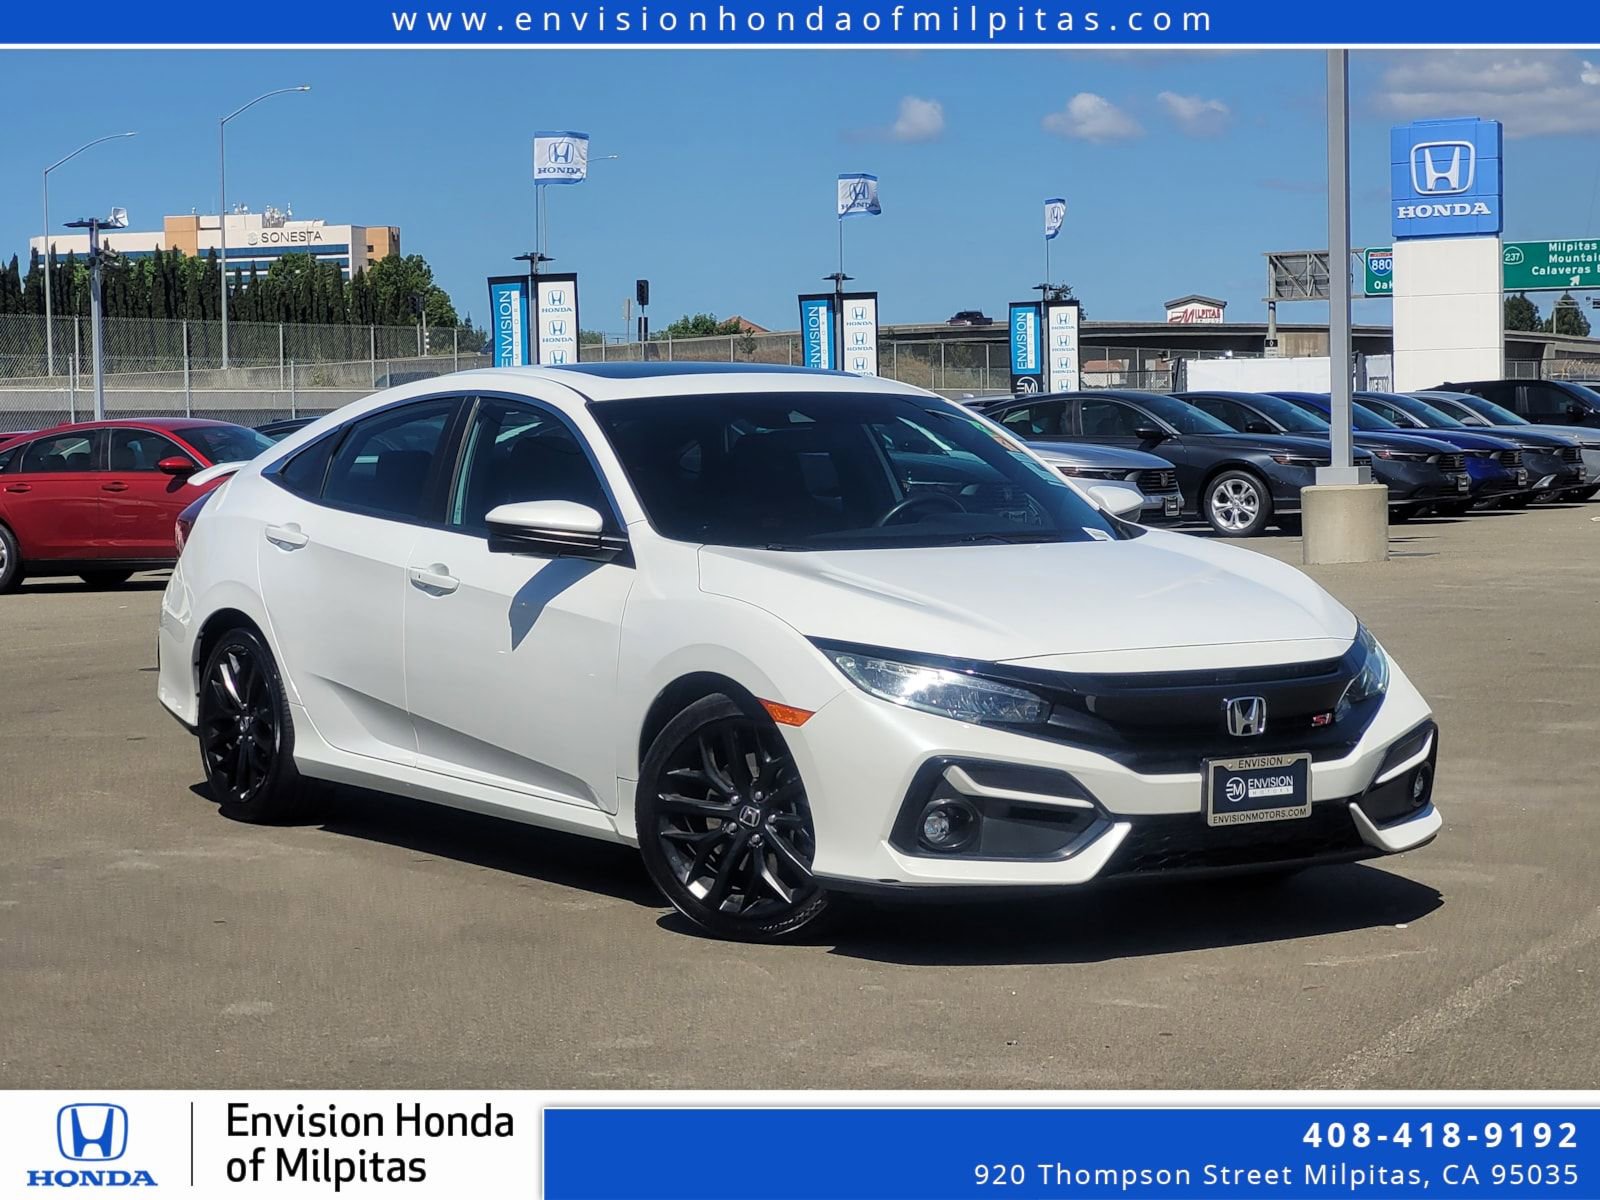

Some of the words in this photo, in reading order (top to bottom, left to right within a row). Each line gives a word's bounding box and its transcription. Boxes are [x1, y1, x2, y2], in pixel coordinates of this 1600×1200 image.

[537, 166, 583, 175] HONDA
[1397, 202, 1492, 219] HONDA
[261, 230, 323, 243] SONESTA
[1548, 241, 1598, 253] Milpitas
[1505, 252, 1521, 262] 237
[1548, 252, 1600, 263] Mountai
[1371, 259, 1392, 270] 880
[1531, 265, 1591, 275] Calaveras
[499, 290, 512, 368] ENVISION
[1016, 312, 1027, 369] ENVISION
[1238, 756, 1283, 769] ENVISION
[1248, 775, 1294, 789] ENVISION
[1213, 808, 1307, 824] ENVISIONMOTORS.COM
